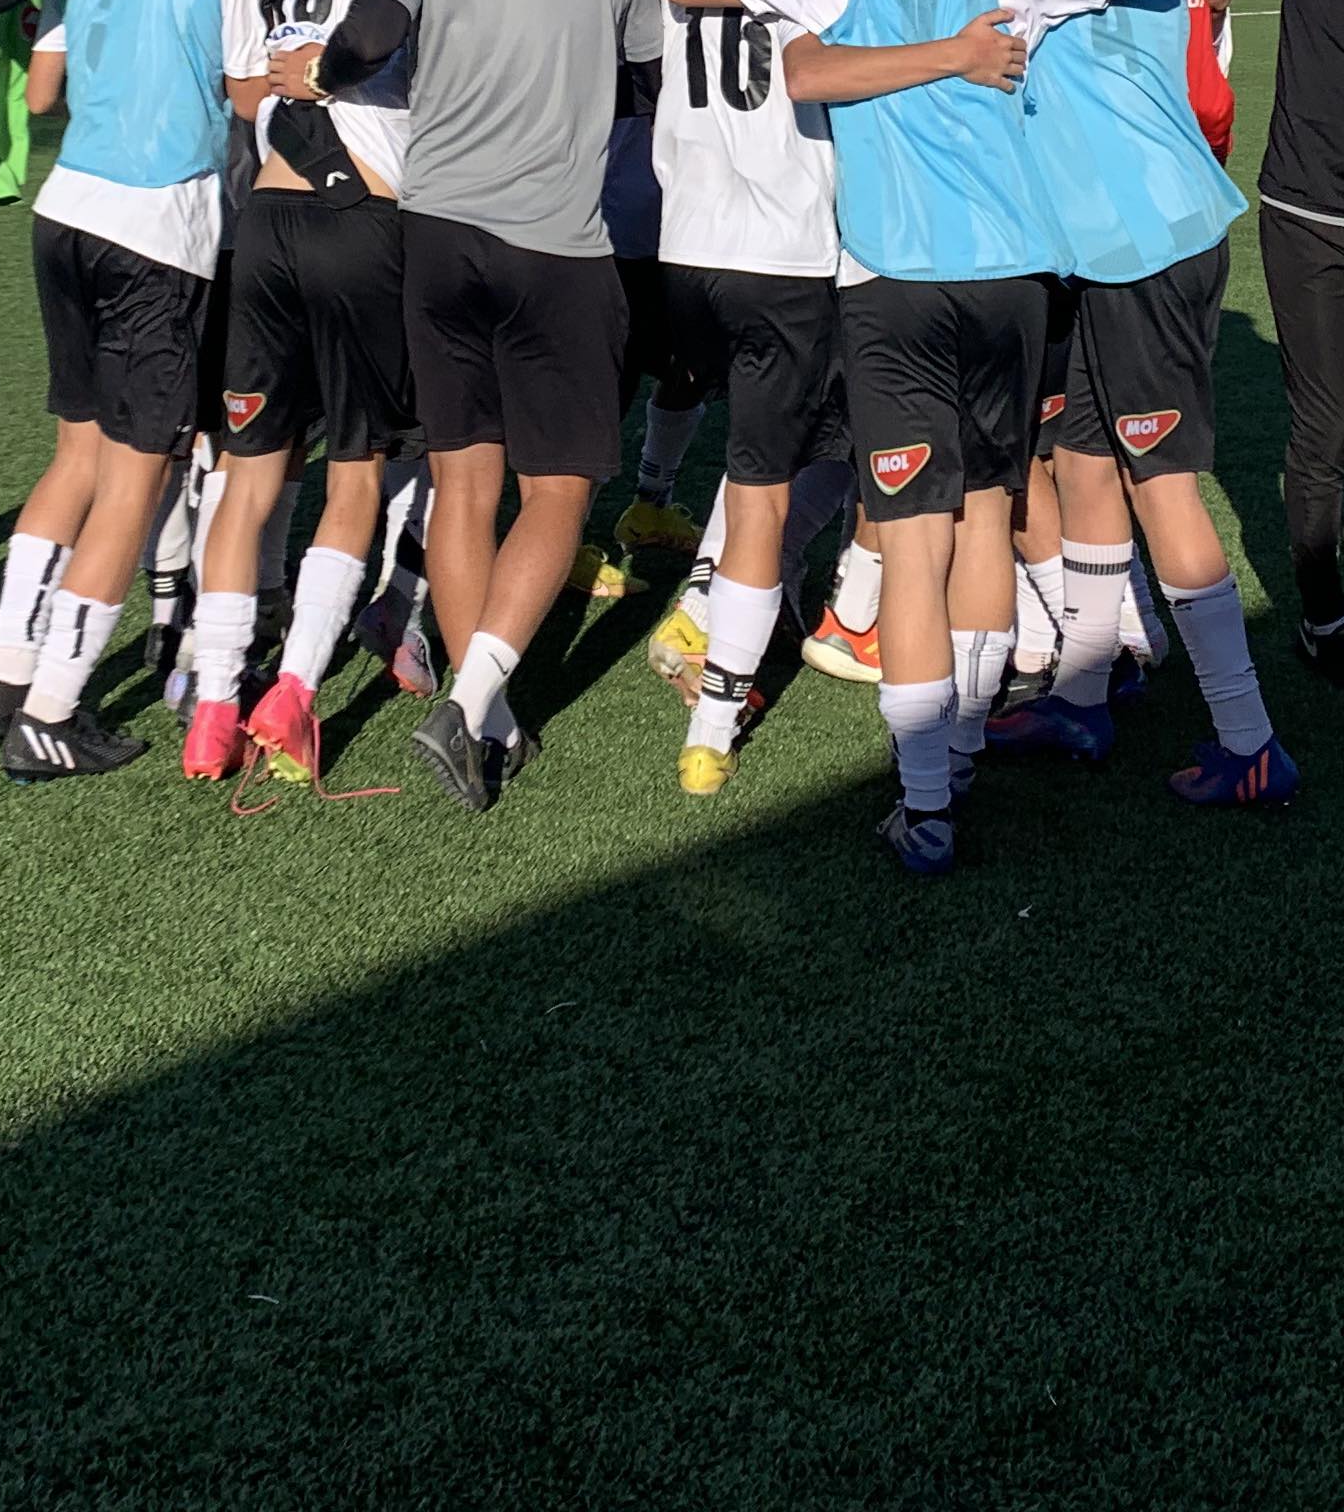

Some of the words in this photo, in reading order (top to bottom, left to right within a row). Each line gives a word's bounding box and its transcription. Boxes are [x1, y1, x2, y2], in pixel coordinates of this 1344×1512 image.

[684, 6, 773, 112] 16
[1125, 417, 1160, 437] MOL
[877, 453, 911, 474] MOL
